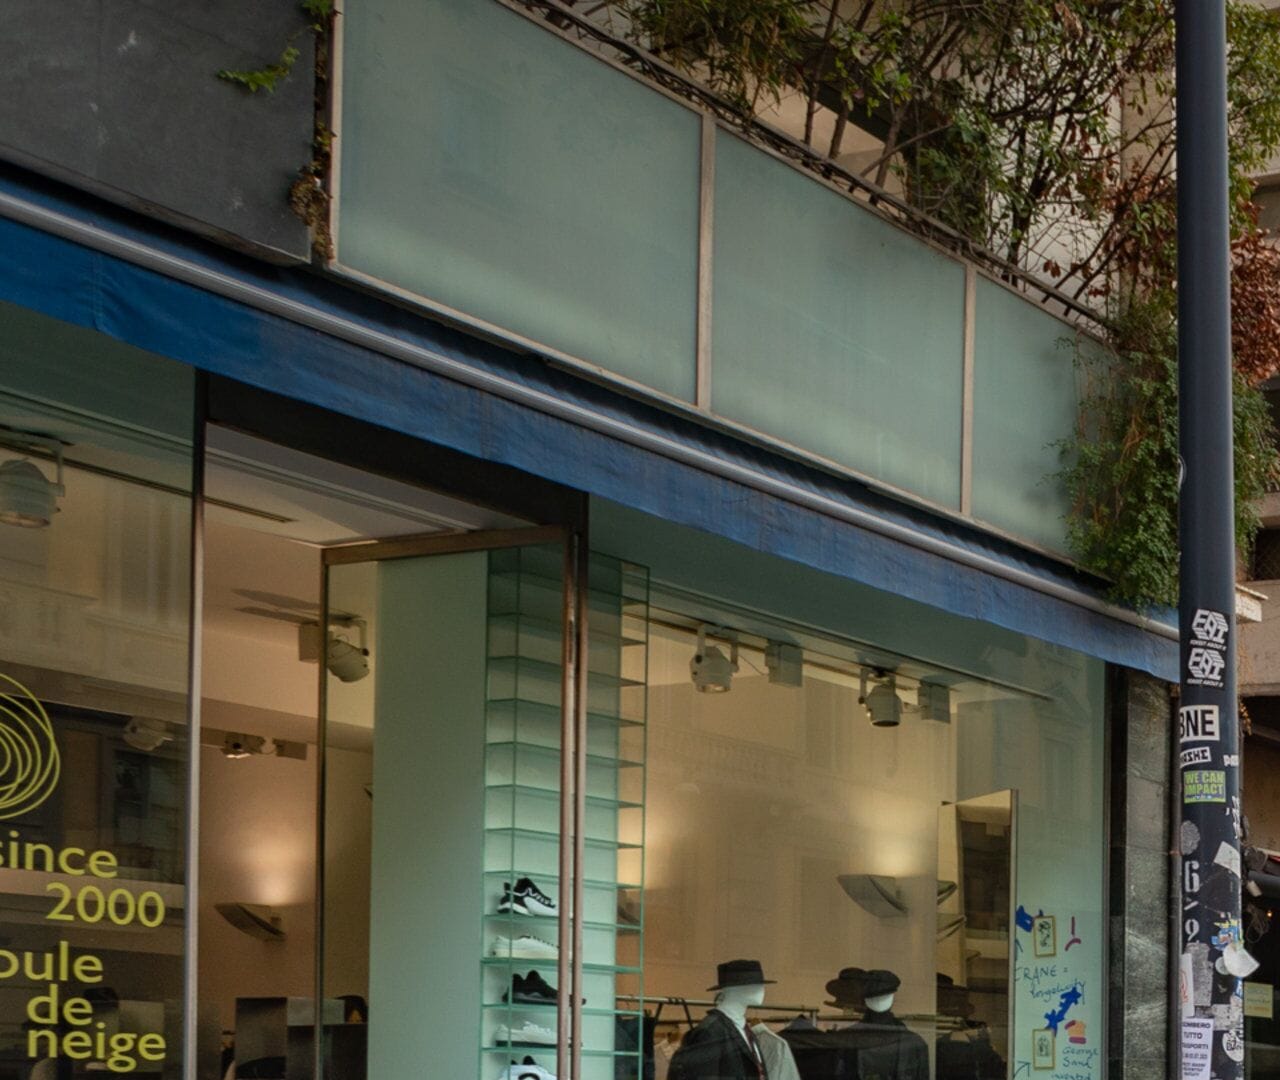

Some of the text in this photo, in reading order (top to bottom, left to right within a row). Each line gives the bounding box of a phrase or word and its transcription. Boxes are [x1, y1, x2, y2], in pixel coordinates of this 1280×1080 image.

[1185, 783, 1225, 795] IMPACT
[1186, 771, 1224, 785] WE CAN
[0, 830, 118, 878] ince
[45, 882, 166, 928] 2000
[26, 983, 93, 1026] de
[27, 1022, 166, 1073] neige
[1062, 1046, 1098, 1060] George
[1062, 1056, 1092, 1069] Sand
